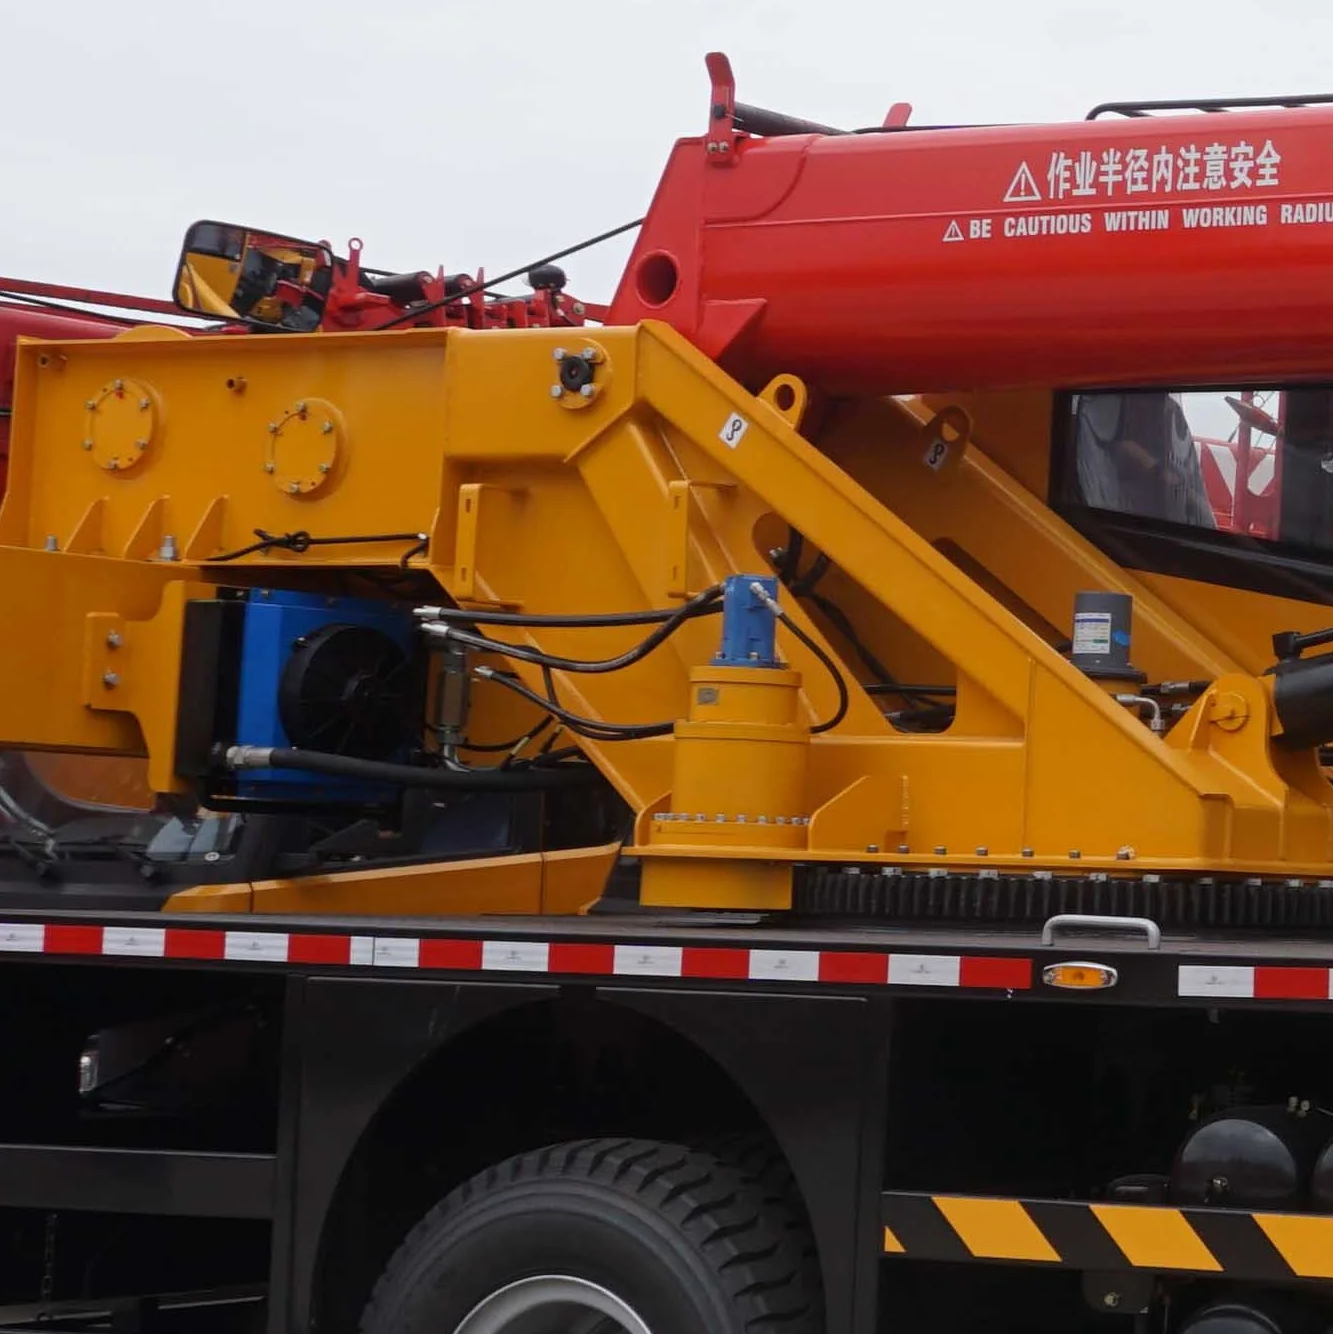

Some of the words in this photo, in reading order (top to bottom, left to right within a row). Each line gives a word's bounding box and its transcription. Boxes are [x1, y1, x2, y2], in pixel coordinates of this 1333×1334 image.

[1046, 138, 1284, 200] 作业半径内注意安全
[968, 217, 993, 241] BE
[1003, 213, 1093, 237] CAUTIOUS
[1103, 209, 1170, 233] WITHIN
[1181, 204, 1269, 228] WORKING
